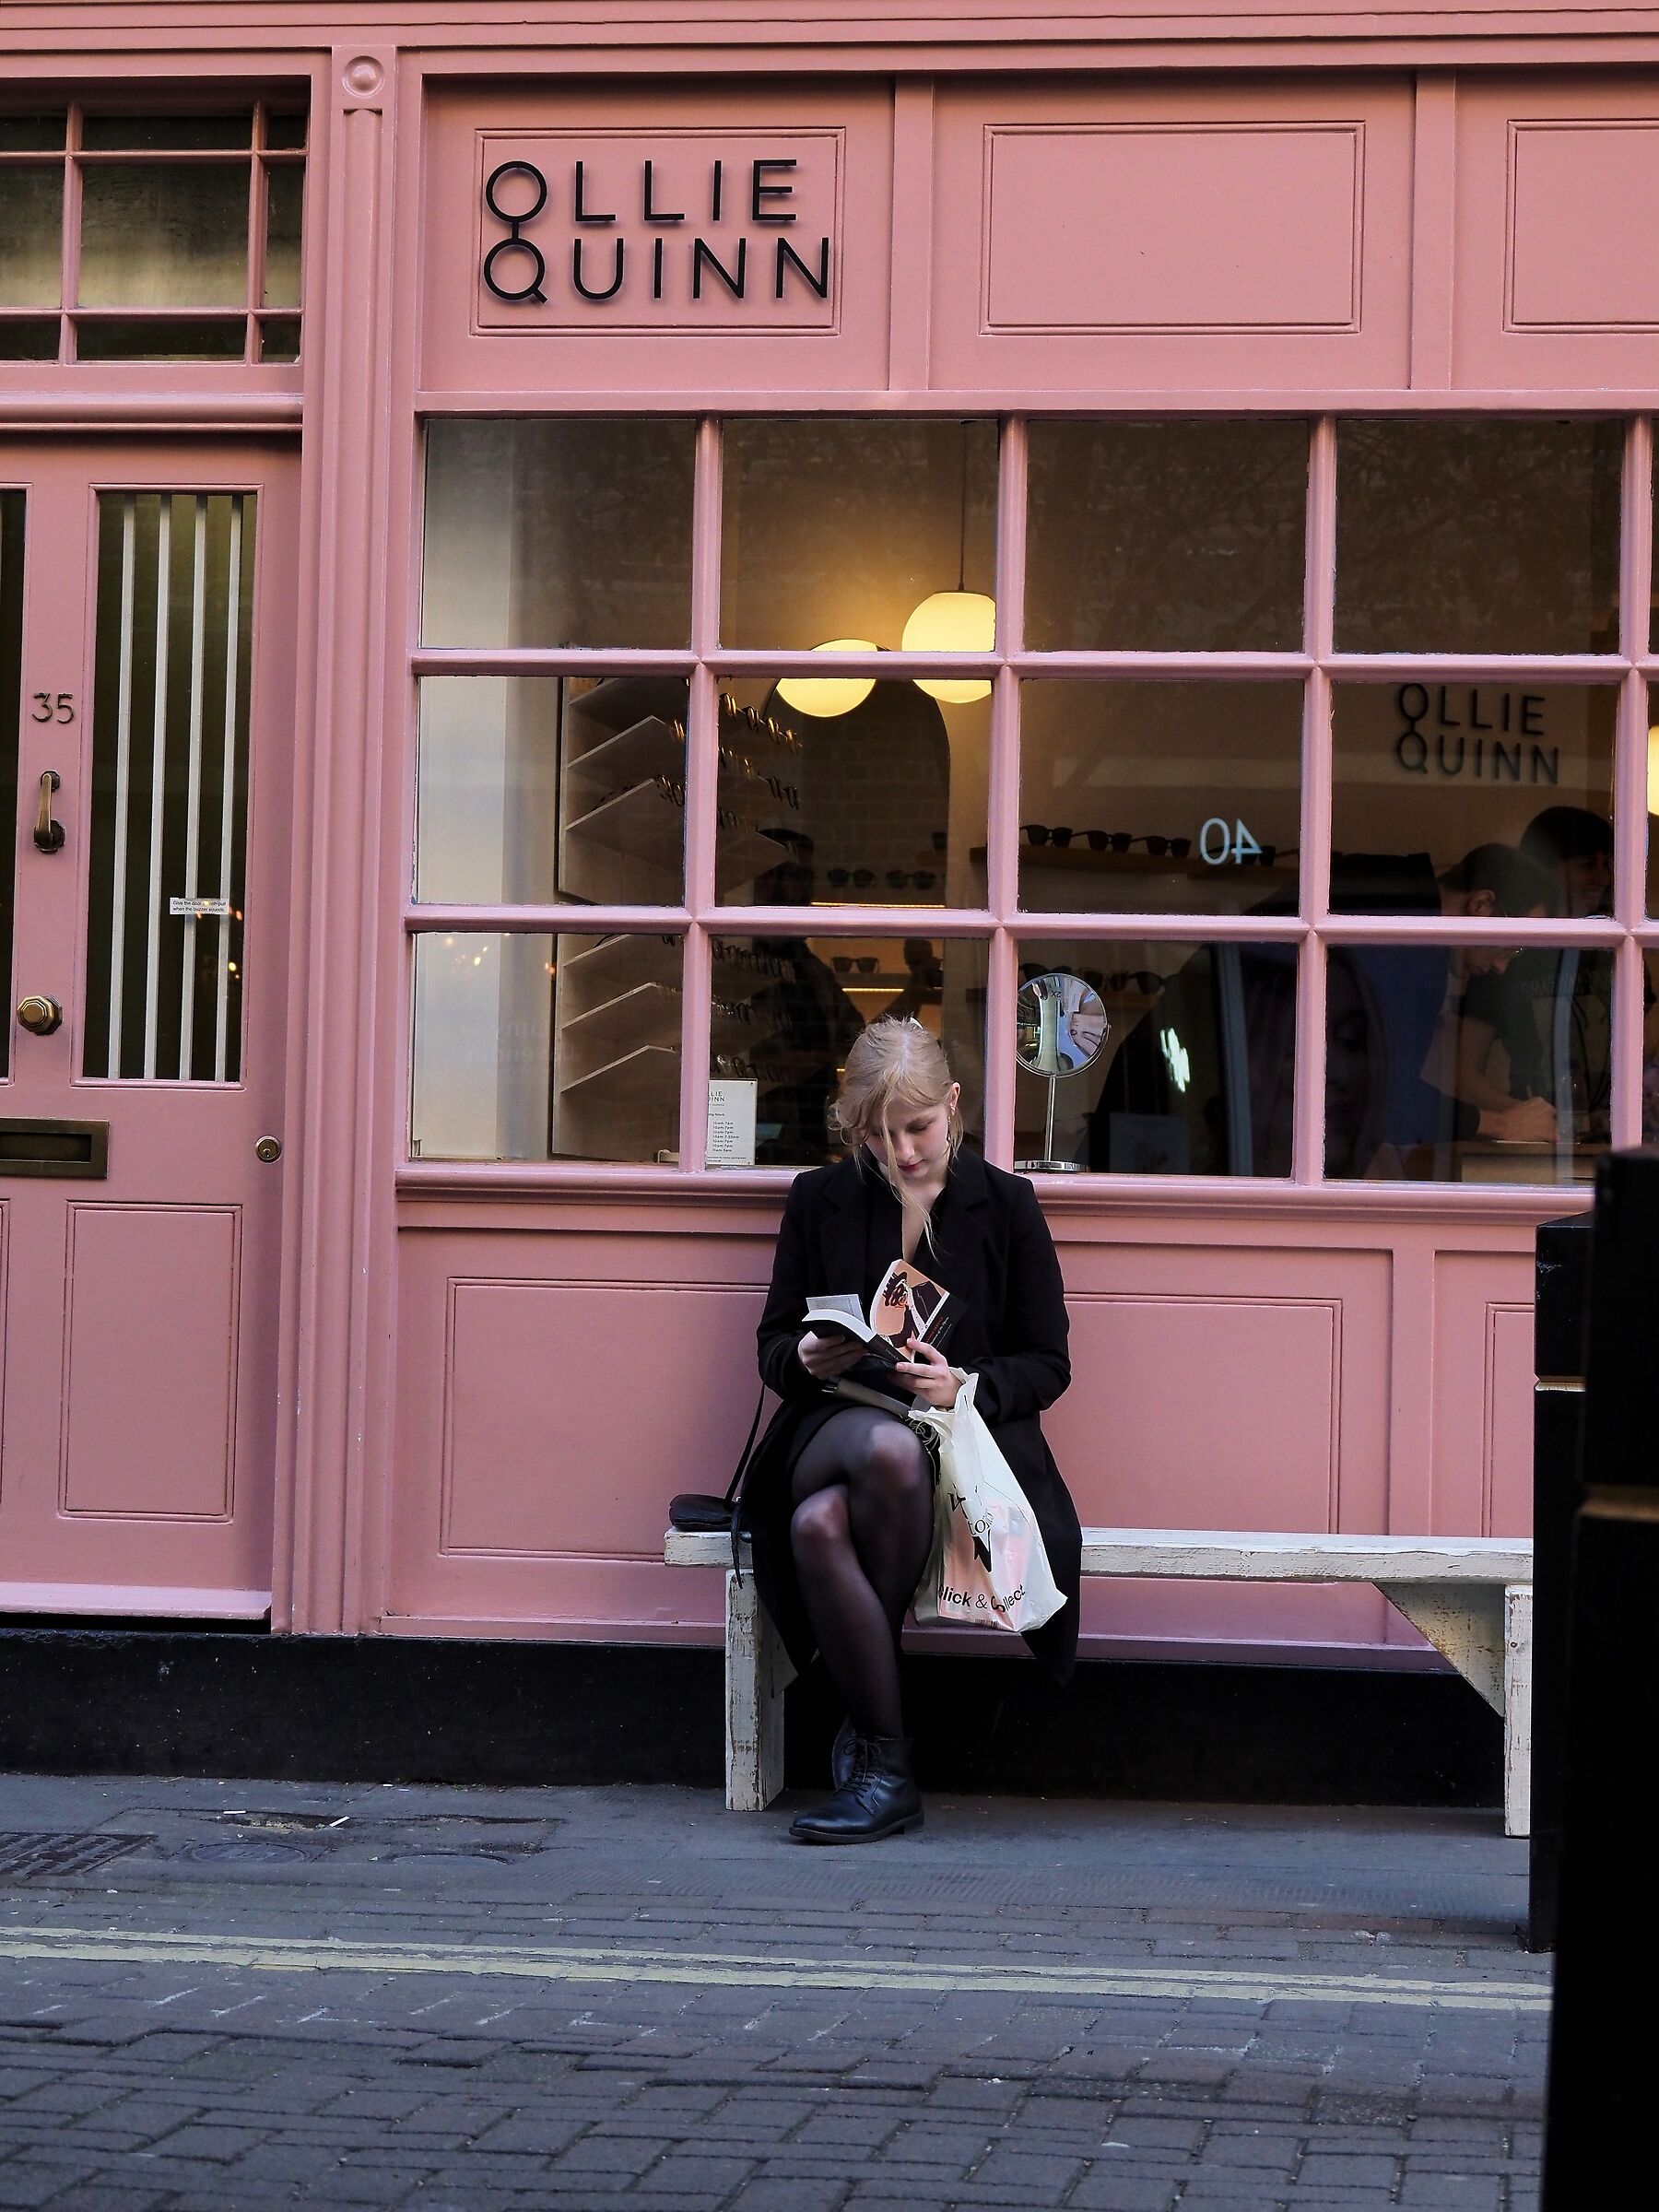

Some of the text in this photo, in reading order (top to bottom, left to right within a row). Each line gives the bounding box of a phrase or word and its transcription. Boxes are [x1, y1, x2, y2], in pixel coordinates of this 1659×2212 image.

[486, 159, 797, 223] OLLIE
[484, 237, 830, 304] QUINN
[31, 692, 75, 724] 35
[1398, 682, 1546, 735] OLLIE
[1395, 731, 1559, 784] QUINN
[975, 1594, 988, 1609] &
